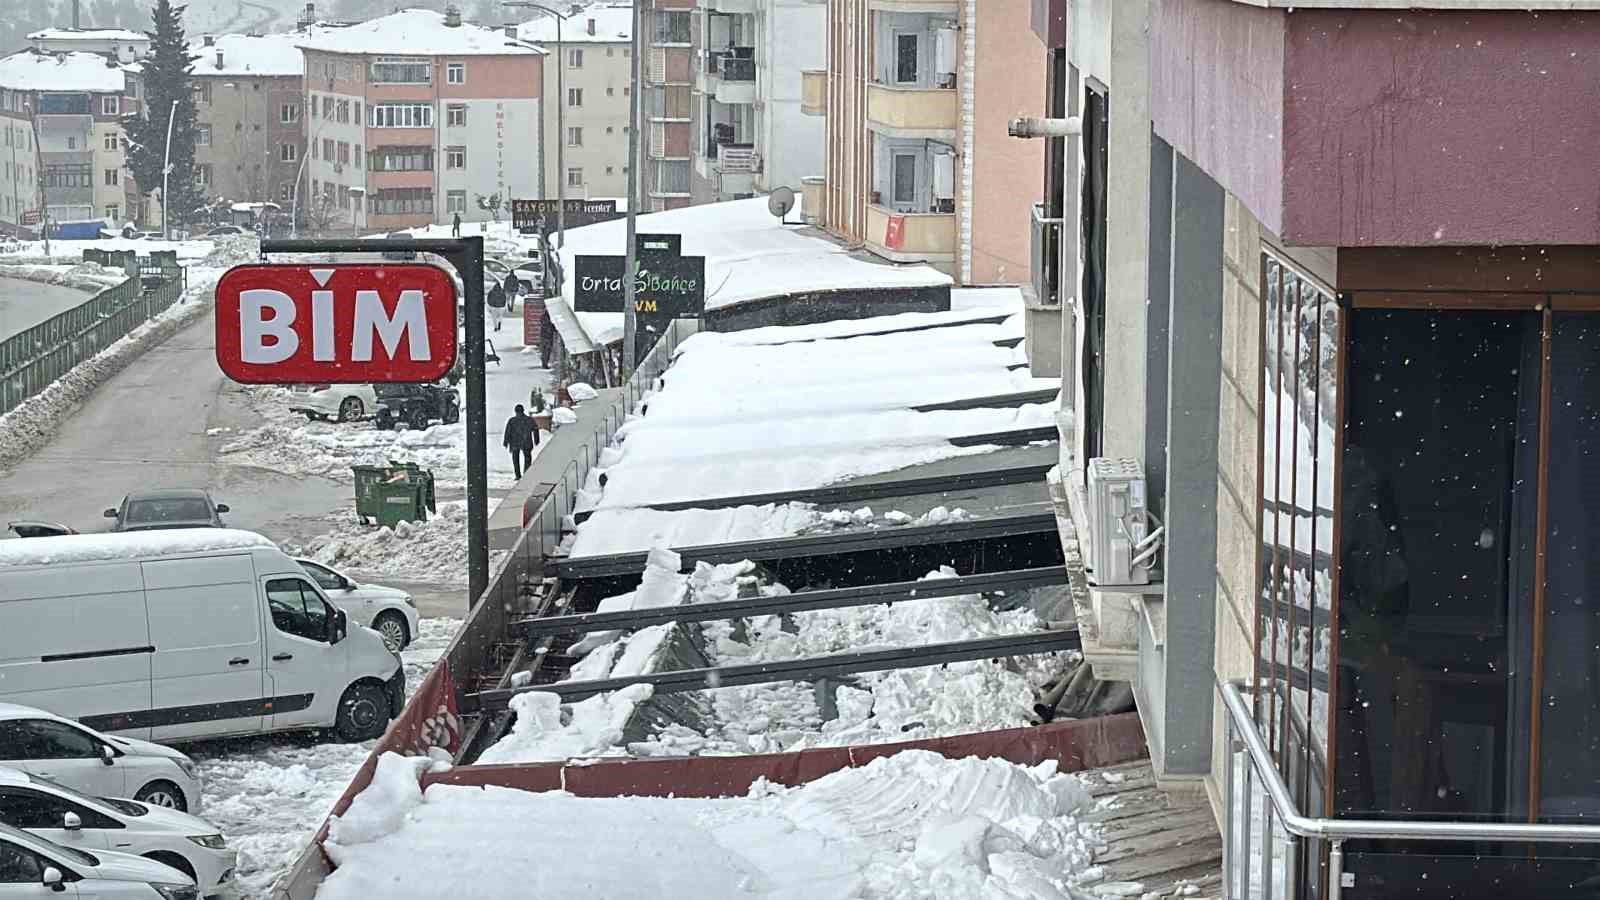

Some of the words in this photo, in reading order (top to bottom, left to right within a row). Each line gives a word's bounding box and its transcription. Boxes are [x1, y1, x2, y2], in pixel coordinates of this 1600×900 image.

[516, 202, 580, 213] SAYGINAR
[582, 276, 621, 292] Orta
[239, 268, 432, 364] BİM
